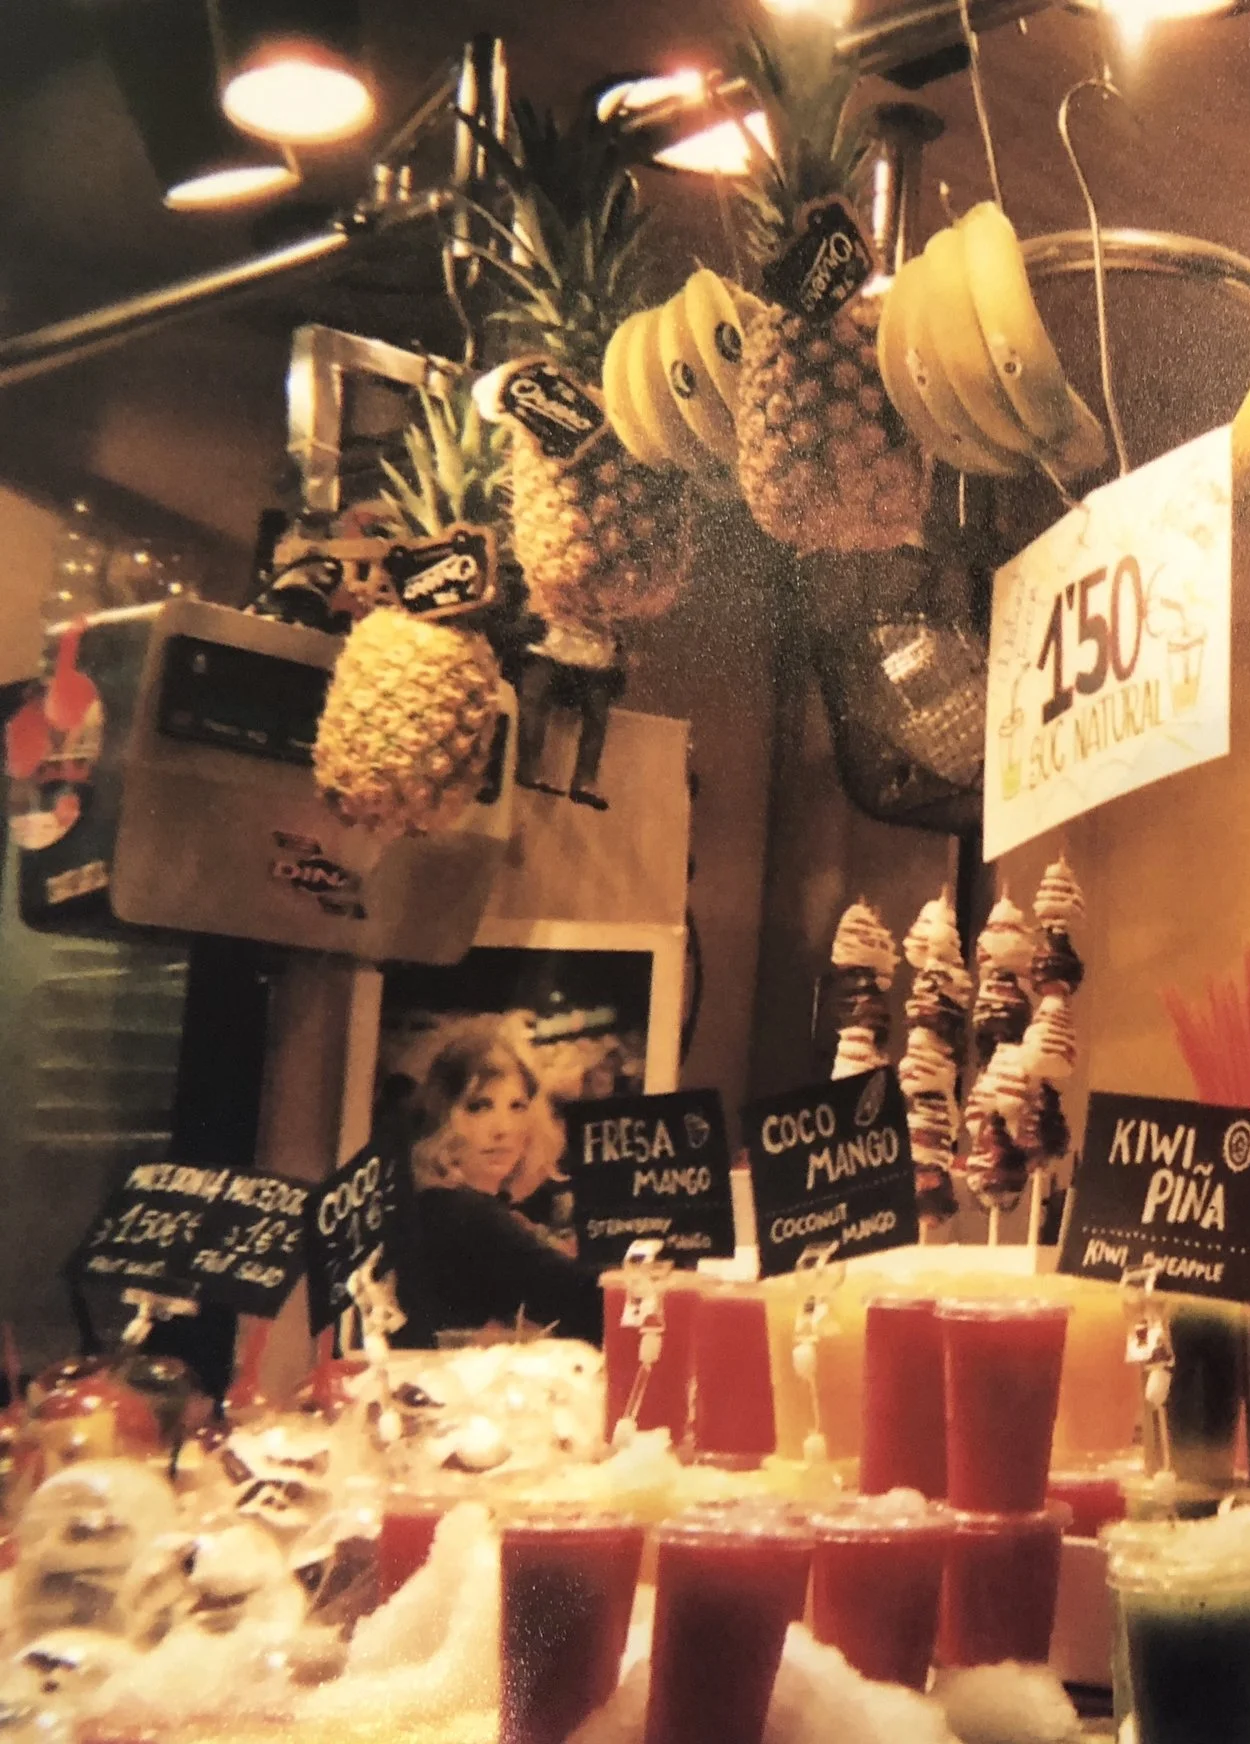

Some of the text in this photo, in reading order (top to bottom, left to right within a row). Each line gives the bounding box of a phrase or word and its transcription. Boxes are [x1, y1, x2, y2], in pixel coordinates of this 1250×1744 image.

[1074, 678, 1166, 765] NATURAL
[583, 1117, 676, 1166] FRESA
[759, 1104, 836, 1154] COCO
[1108, 1118, 1196, 1170] KIWI
[632, 1165, 712, 1198] MANGO
[806, 1127, 899, 1190] MANGO
[1141, 1163, 1225, 1231] PIÑA
[769, 1202, 848, 1244] COCONUT
[1082, 1238, 1129, 1268] KIWI
